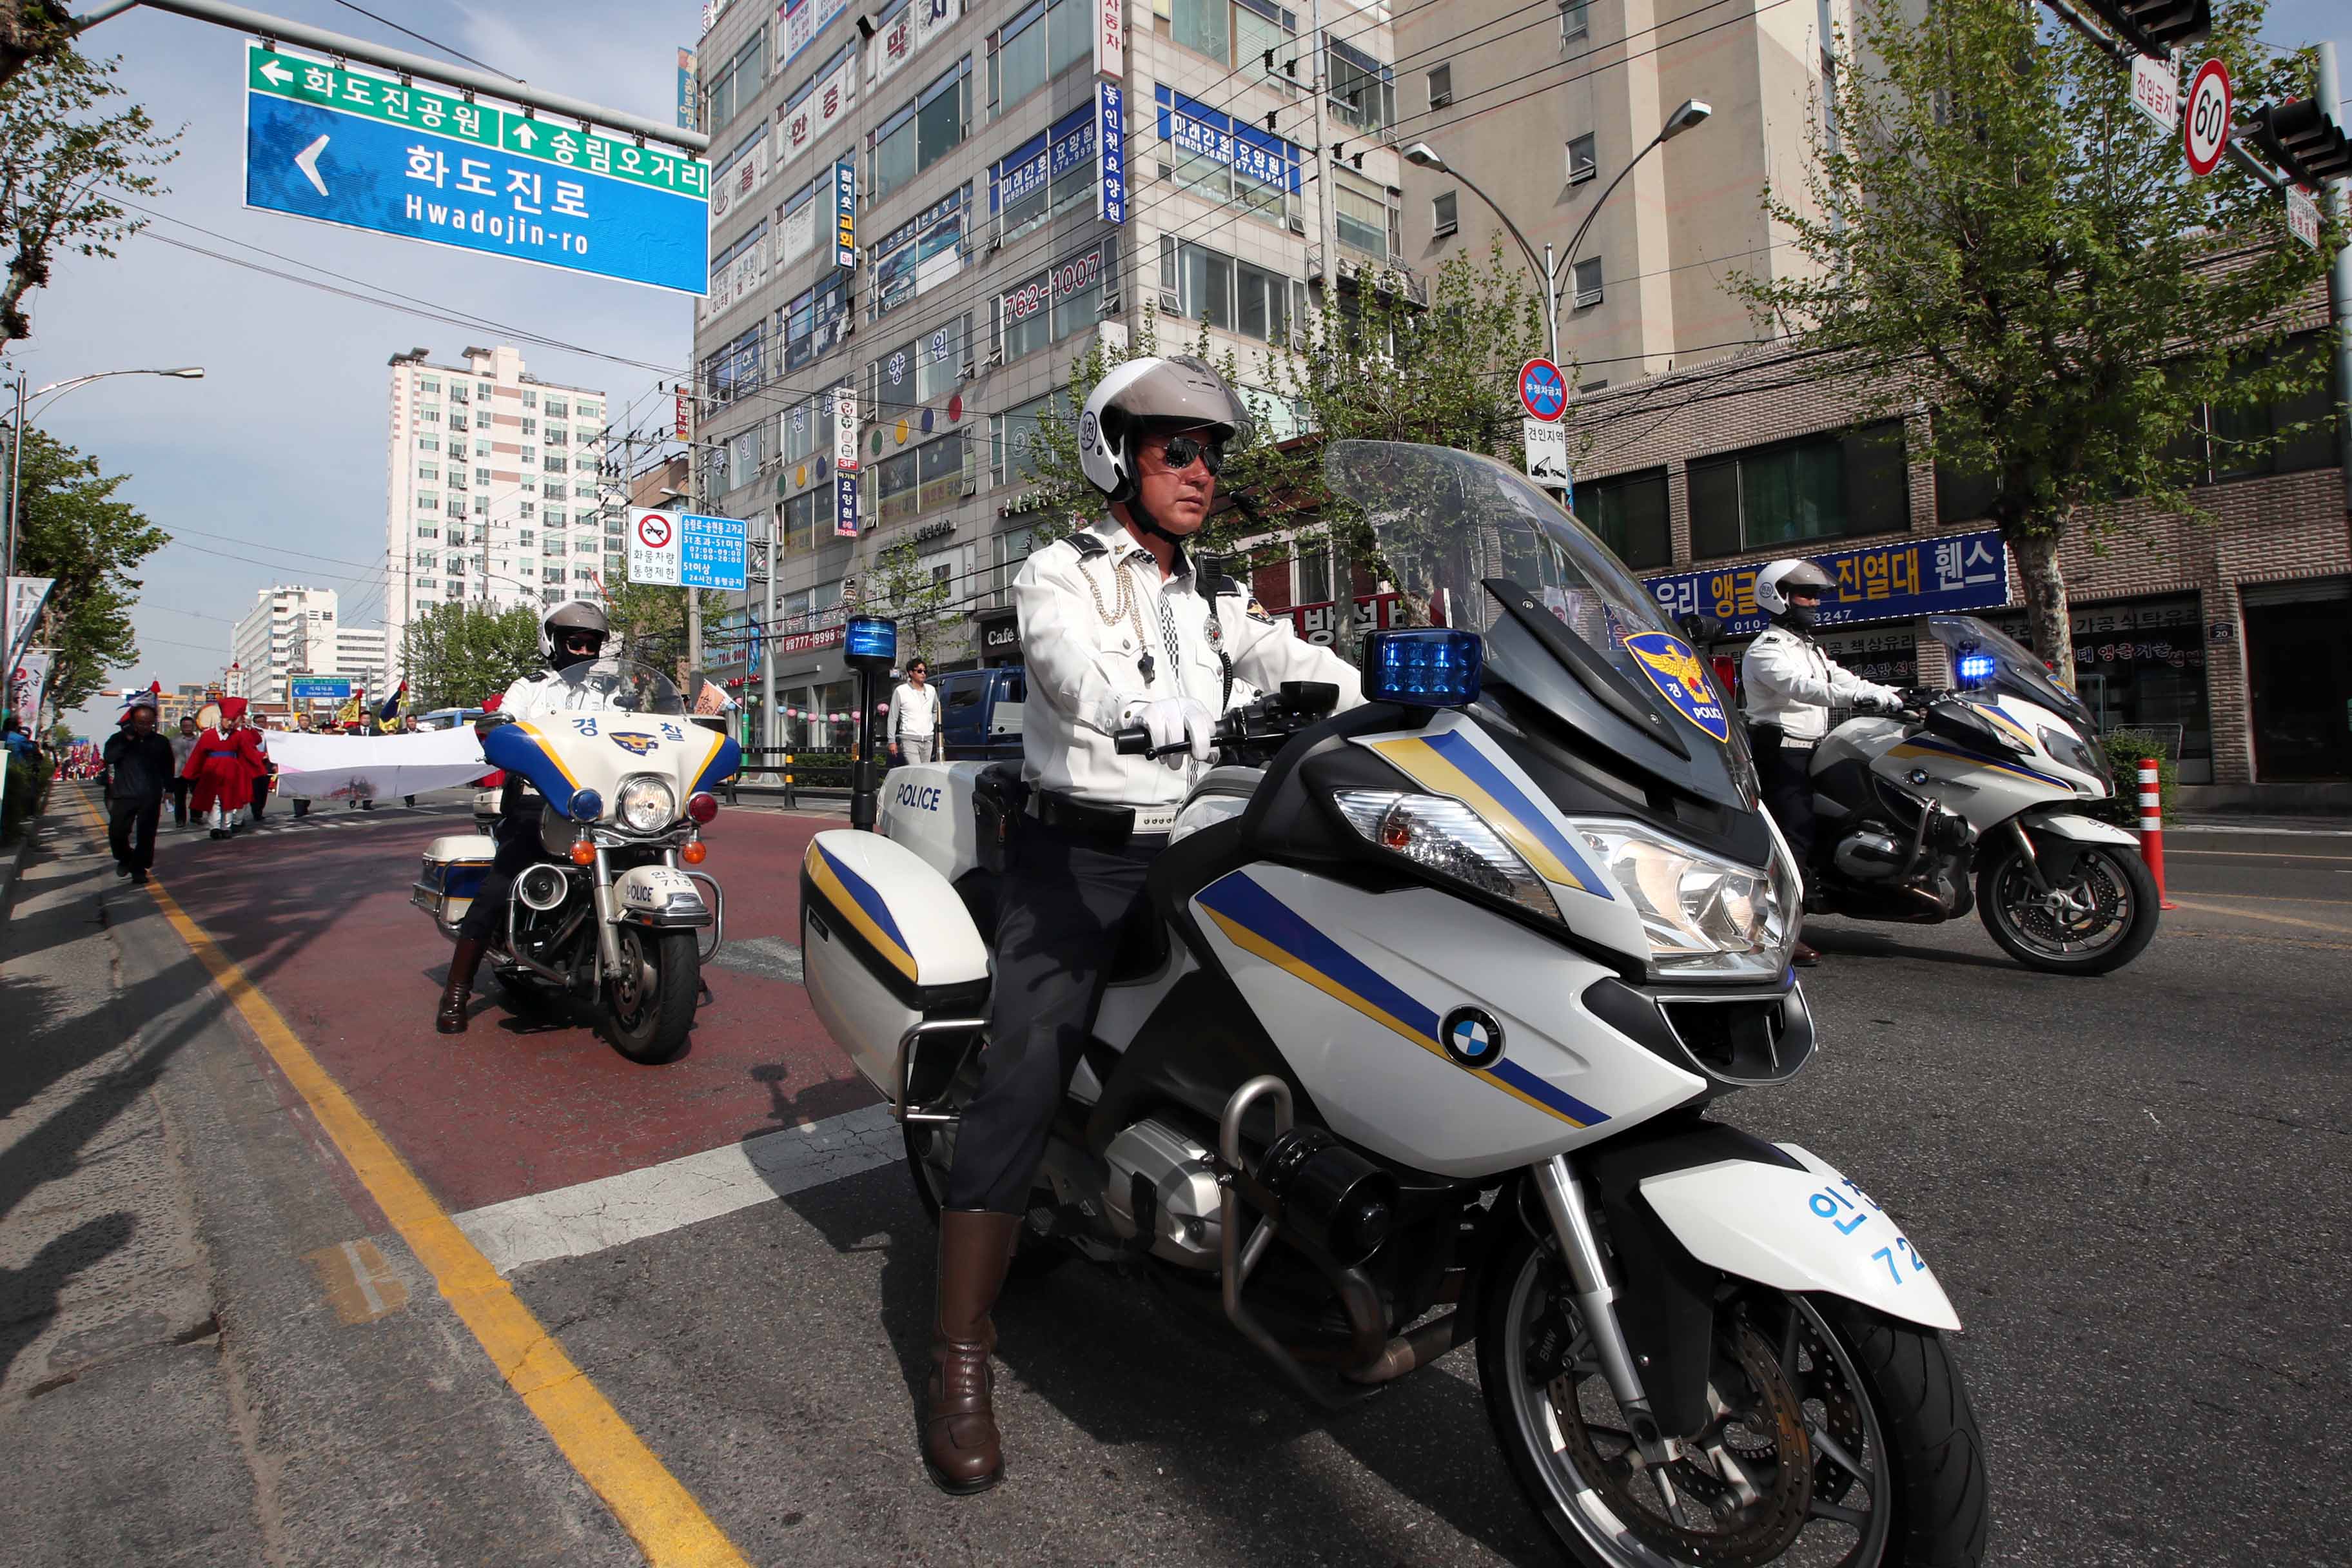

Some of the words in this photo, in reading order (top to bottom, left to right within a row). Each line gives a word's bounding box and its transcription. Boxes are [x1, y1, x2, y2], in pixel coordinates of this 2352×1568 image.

[303, 66, 480, 139] 화도진공원
[2137, 72, 2173, 122] 진입금지
[2195, 89, 2222, 146] 60
[1003, 155, 1048, 194] 미래간호
[1056, 122, 1093, 162] 요양원
[1053, 140, 1097, 174] 574-9998
[1103, 84, 1121, 223] 동인천요양원
[1175, 115, 1230, 155] 미래간호
[1239, 143, 1280, 175] 요양원
[550, 130, 707, 195] 송림오거리
[1235, 159, 1284, 188] 574-9998
[405, 144, 590, 219] 화도진로
[406, 193, 589, 255] Hwadojin-ro
[841, 253, 852, 263] 5F
[1004, 251, 1100, 325] 762-1007
[1525, 383, 1562, 398] 주정차금지
[1528, 427, 1563, 444] 견인지역
[840, 459, 856, 468] 3F
[842, 481, 853, 518] 요양원
[633, 549, 675, 565] 화물차량
[689, 546, 741, 557] 07:00-09:00
[691, 553, 741, 564] 18:00-20:00
[633, 564, 675, 580] 통행제한
[1838, 547, 1919, 603] 진열대
[795, 629, 836, 649] 777-9998
[988, 627, 1014, 645] Café
[572, 717, 598, 737] 경
[660, 722, 685, 742] 찰
[896, 783, 941, 812] POLICE
[625, 885, 654, 902] POLICE
